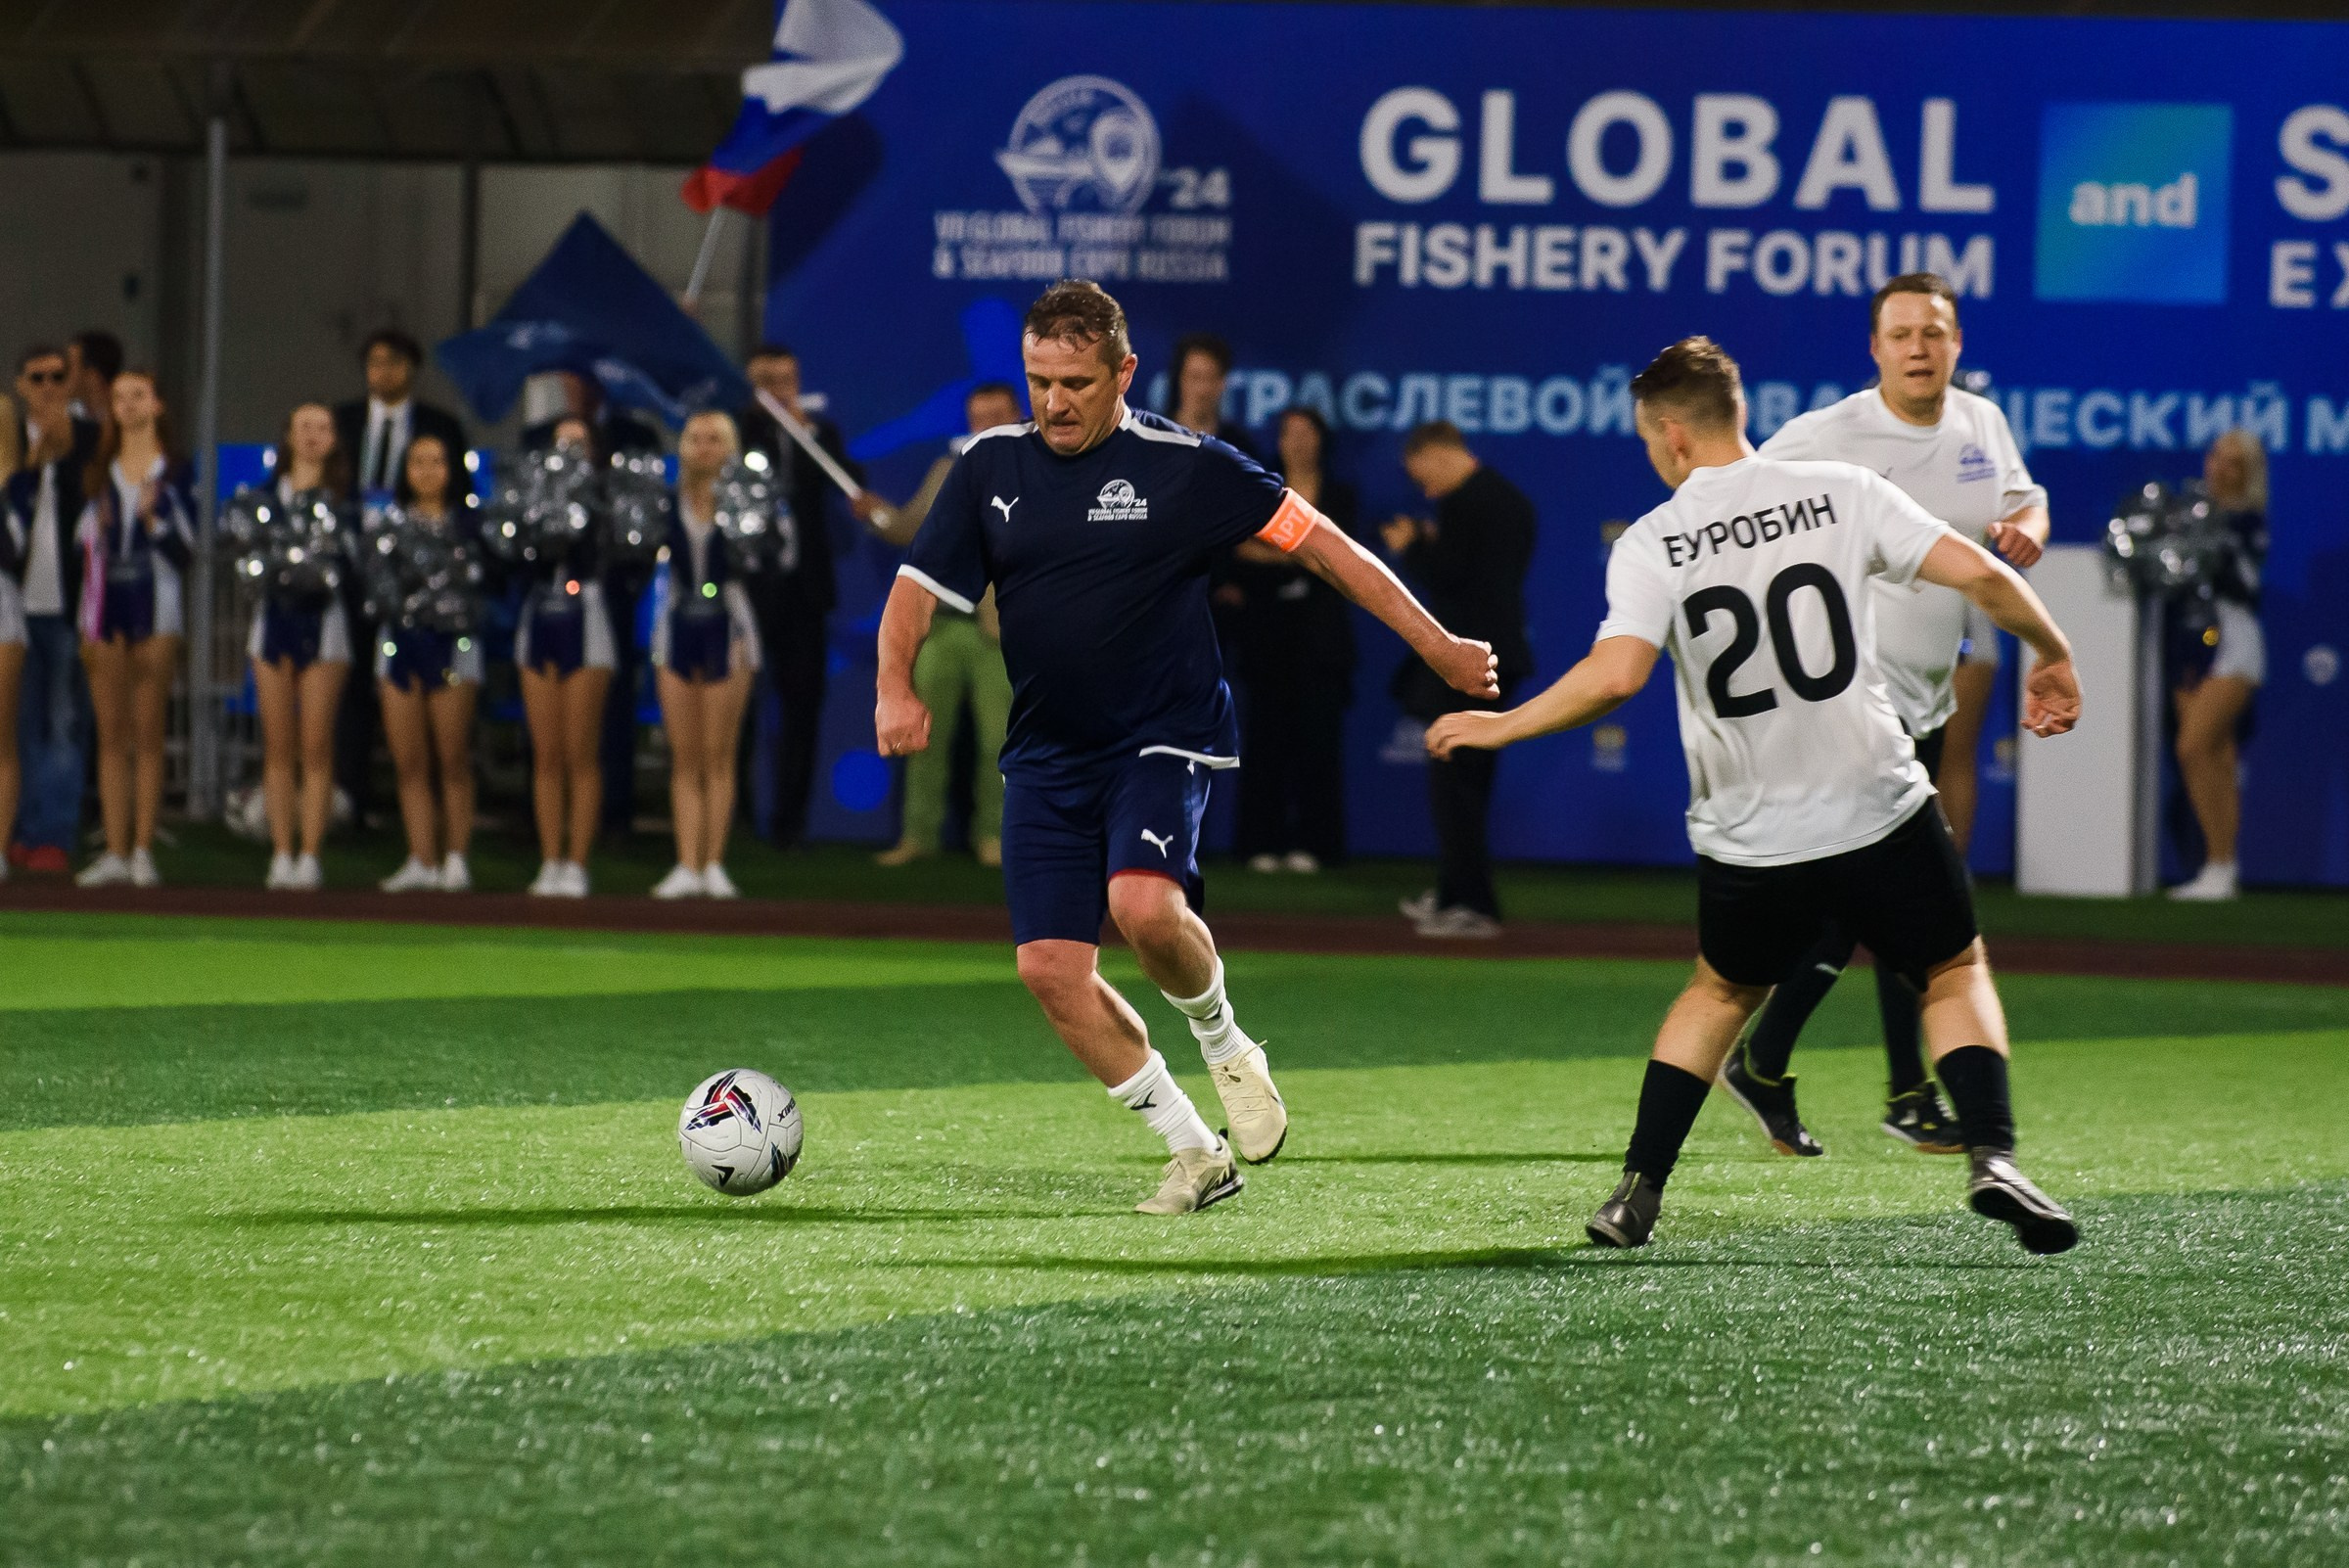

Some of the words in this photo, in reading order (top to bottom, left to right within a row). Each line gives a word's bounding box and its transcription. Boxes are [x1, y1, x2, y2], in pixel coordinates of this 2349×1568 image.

[1359, 85, 1995, 214] GLOBAL
[2068, 171, 2199, 229] and
[1354, 221, 1686, 291] FISHERY
[1707, 228, 1995, 299] FORUM
[1662, 493, 1837, 568] ЕУРОБИН
[1682, 563, 1857, 718] 20
